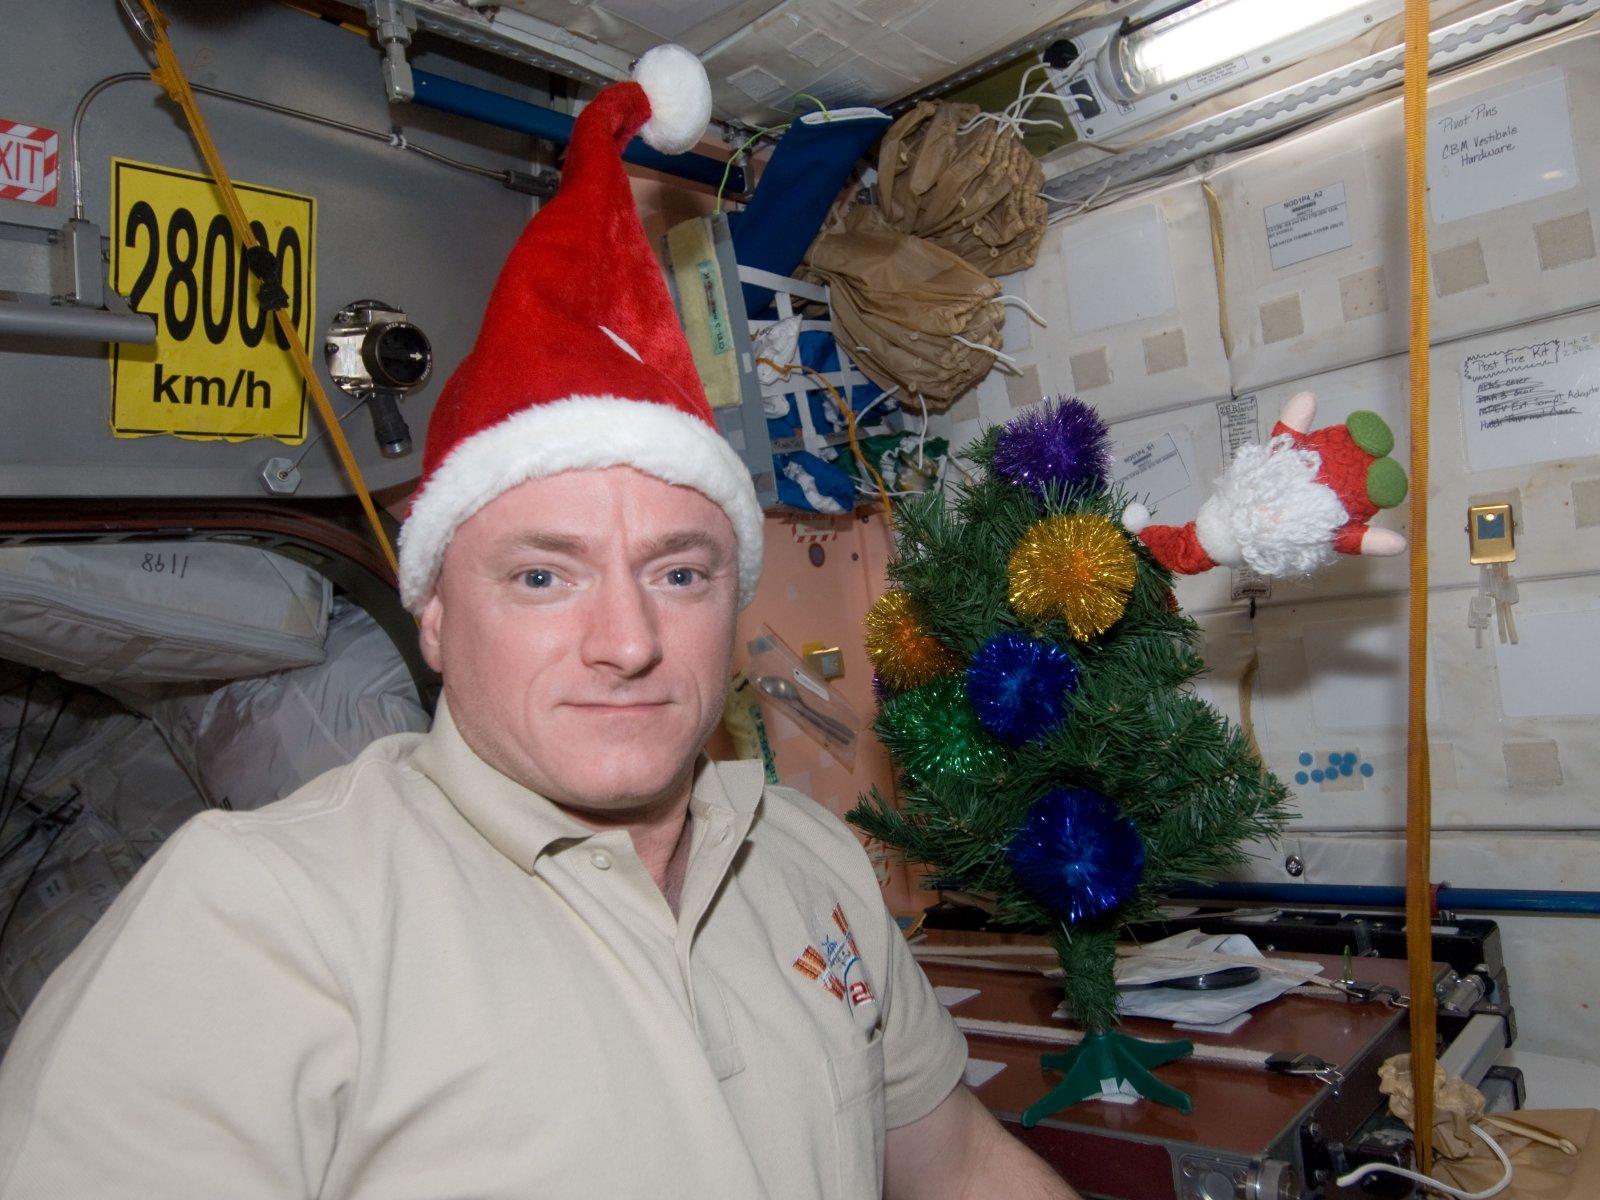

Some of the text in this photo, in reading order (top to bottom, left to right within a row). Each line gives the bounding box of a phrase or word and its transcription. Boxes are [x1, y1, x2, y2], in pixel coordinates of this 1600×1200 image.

[1438, 103, 1499, 133] Pivot Pins
[1442, 140, 1468, 159] CBM
[1461, 143, 1516, 167] Hardware
[125, 200, 302, 351] 28000
[1472, 346, 1549, 372] Post Fire Kit
[153, 363, 272, 409] km/h
